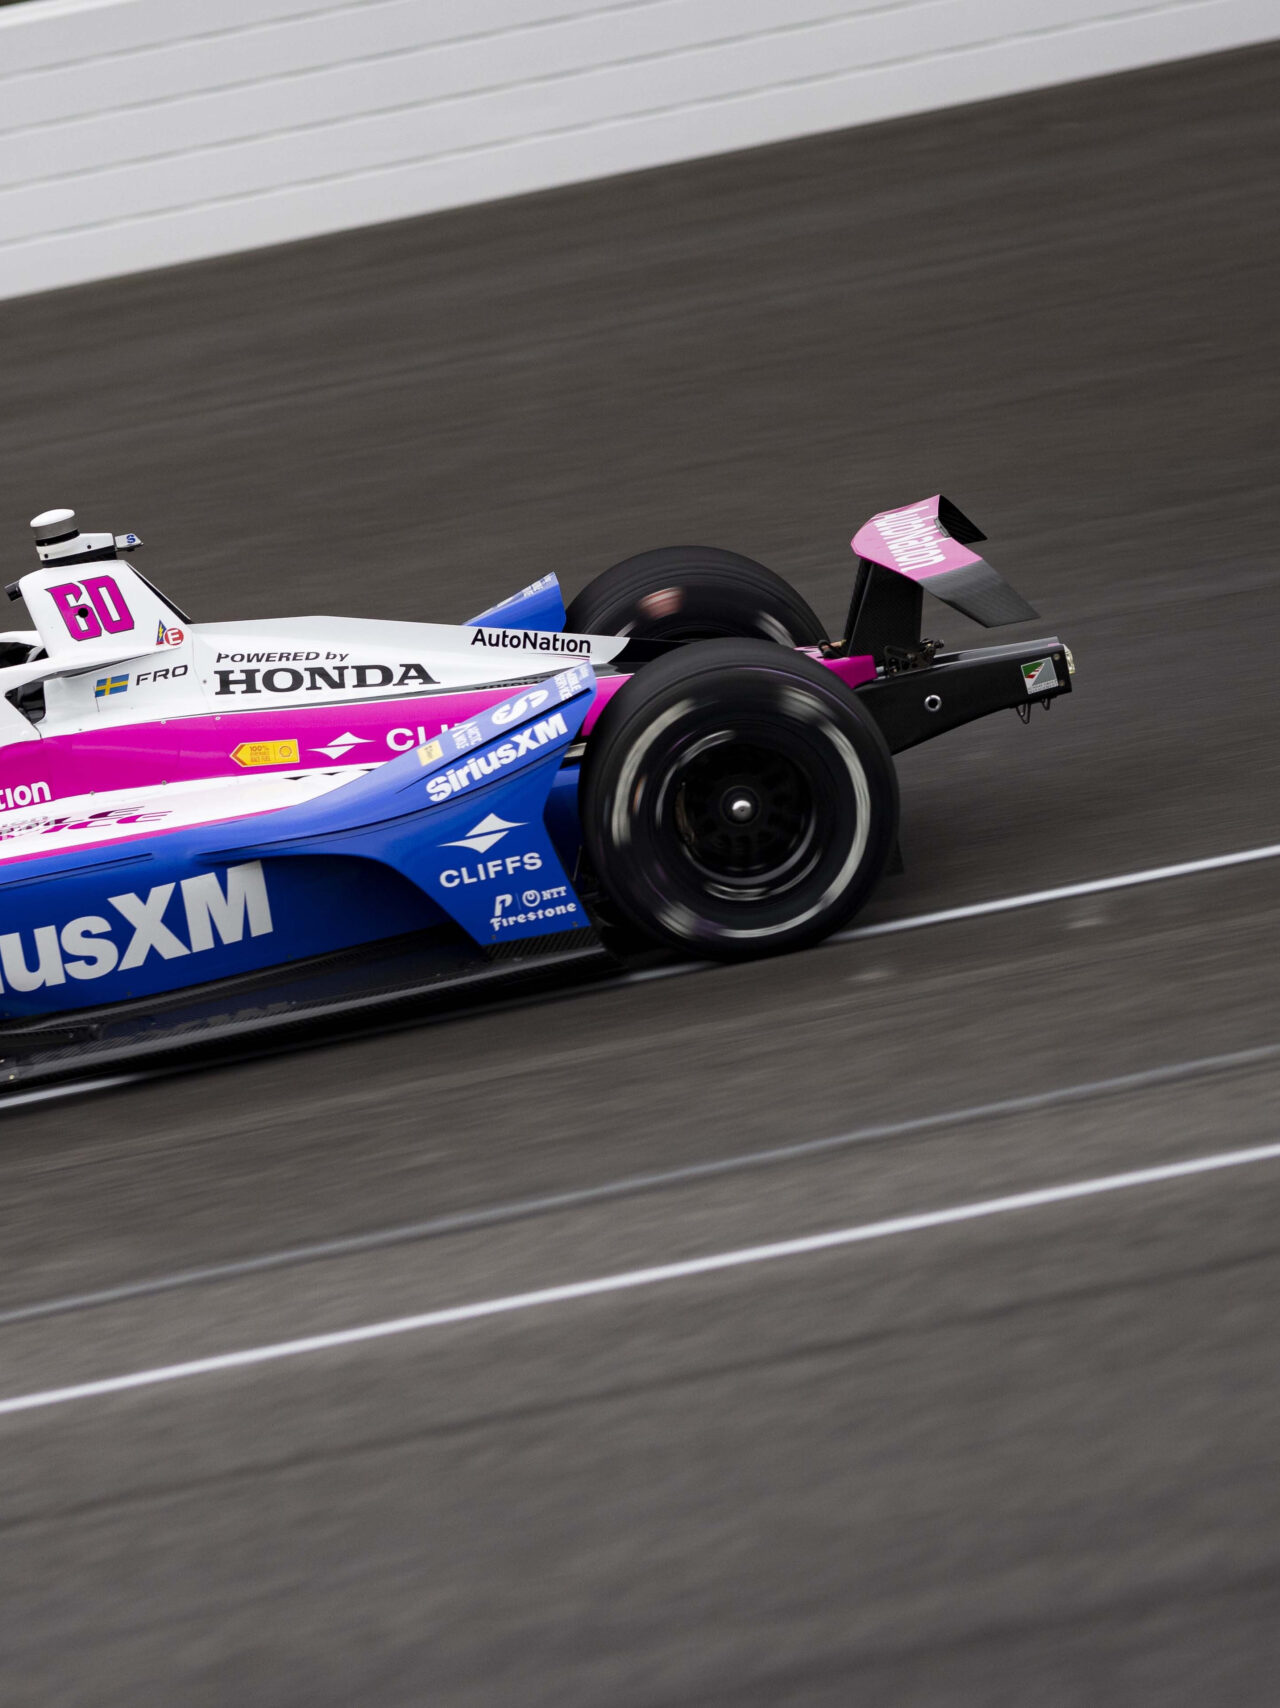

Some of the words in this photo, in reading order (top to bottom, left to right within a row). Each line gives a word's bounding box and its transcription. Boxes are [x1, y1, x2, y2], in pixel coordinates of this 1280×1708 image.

[44, 575, 134, 641] 60
[471, 628, 591, 653] AutoNation
[216, 651, 320, 663] POWERED
[324, 651, 349, 662] by
[136, 665, 188, 686] FRO
[214, 663, 441, 696] HONDA
[425, 712, 568, 802] SiriusXM
[439, 852, 543, 888] CLIFFS
[541, 886, 567, 901] NTT
[490, 902, 577, 932] Firestone
